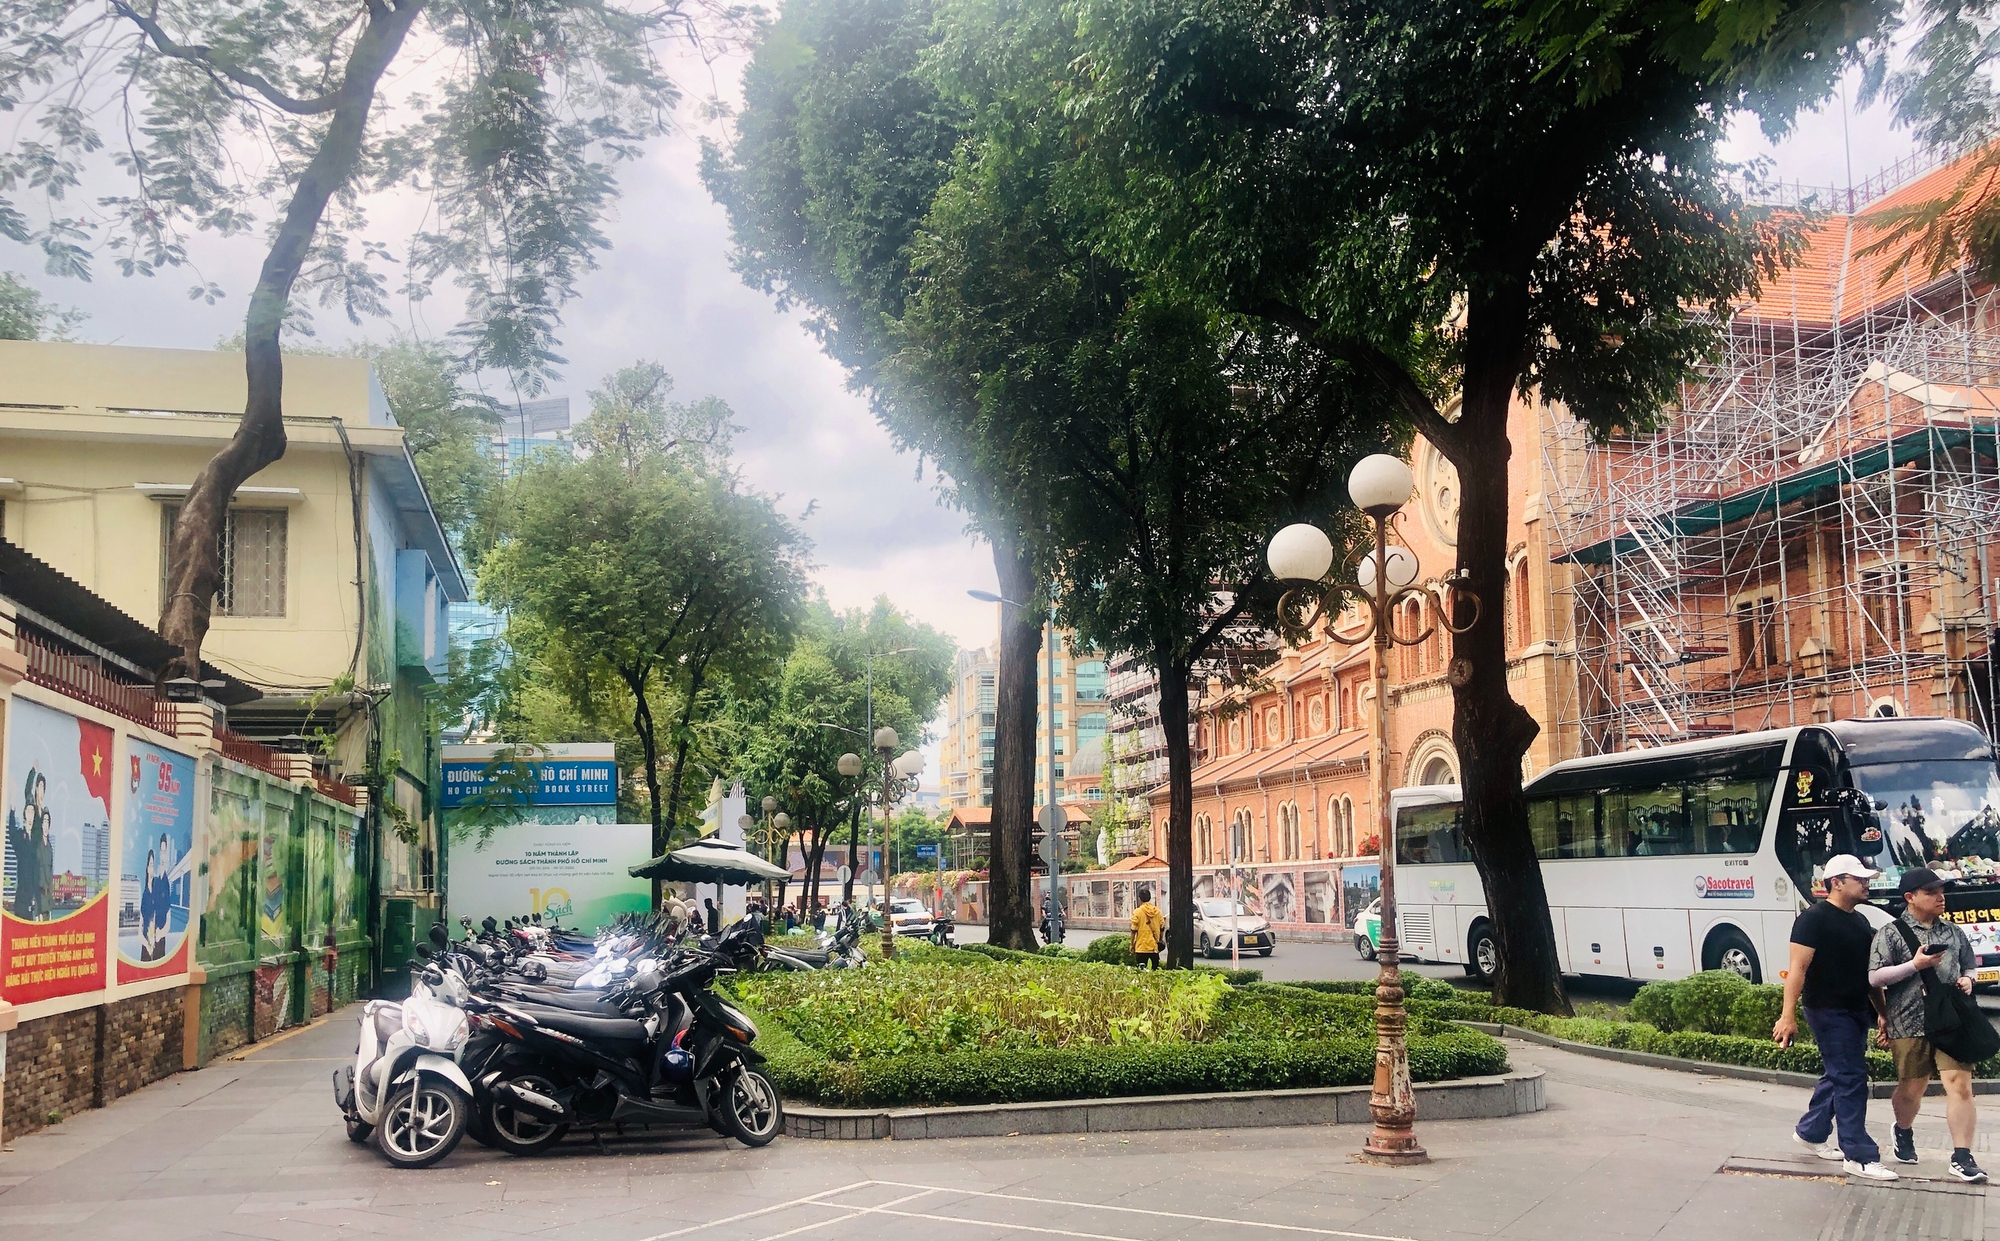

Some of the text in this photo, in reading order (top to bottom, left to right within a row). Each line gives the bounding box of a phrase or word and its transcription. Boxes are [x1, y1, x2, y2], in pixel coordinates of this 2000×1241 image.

[158, 761, 173, 792] 95
[447, 766, 485, 783] ĐƯỜNG
[540, 765, 555, 781] HỒ
[559, 765, 579, 781] CHÍ
[581, 768, 609, 781] MINH
[447, 786, 460, 795] HO
[465, 786, 482, 795] CHI
[545, 784, 570, 793] BOOK
[575, 784, 609, 793] STREET
[1707, 875, 1755, 890] Sacotravel
[529, 887, 571, 915] 10
[543, 899, 574, 920] Sách
